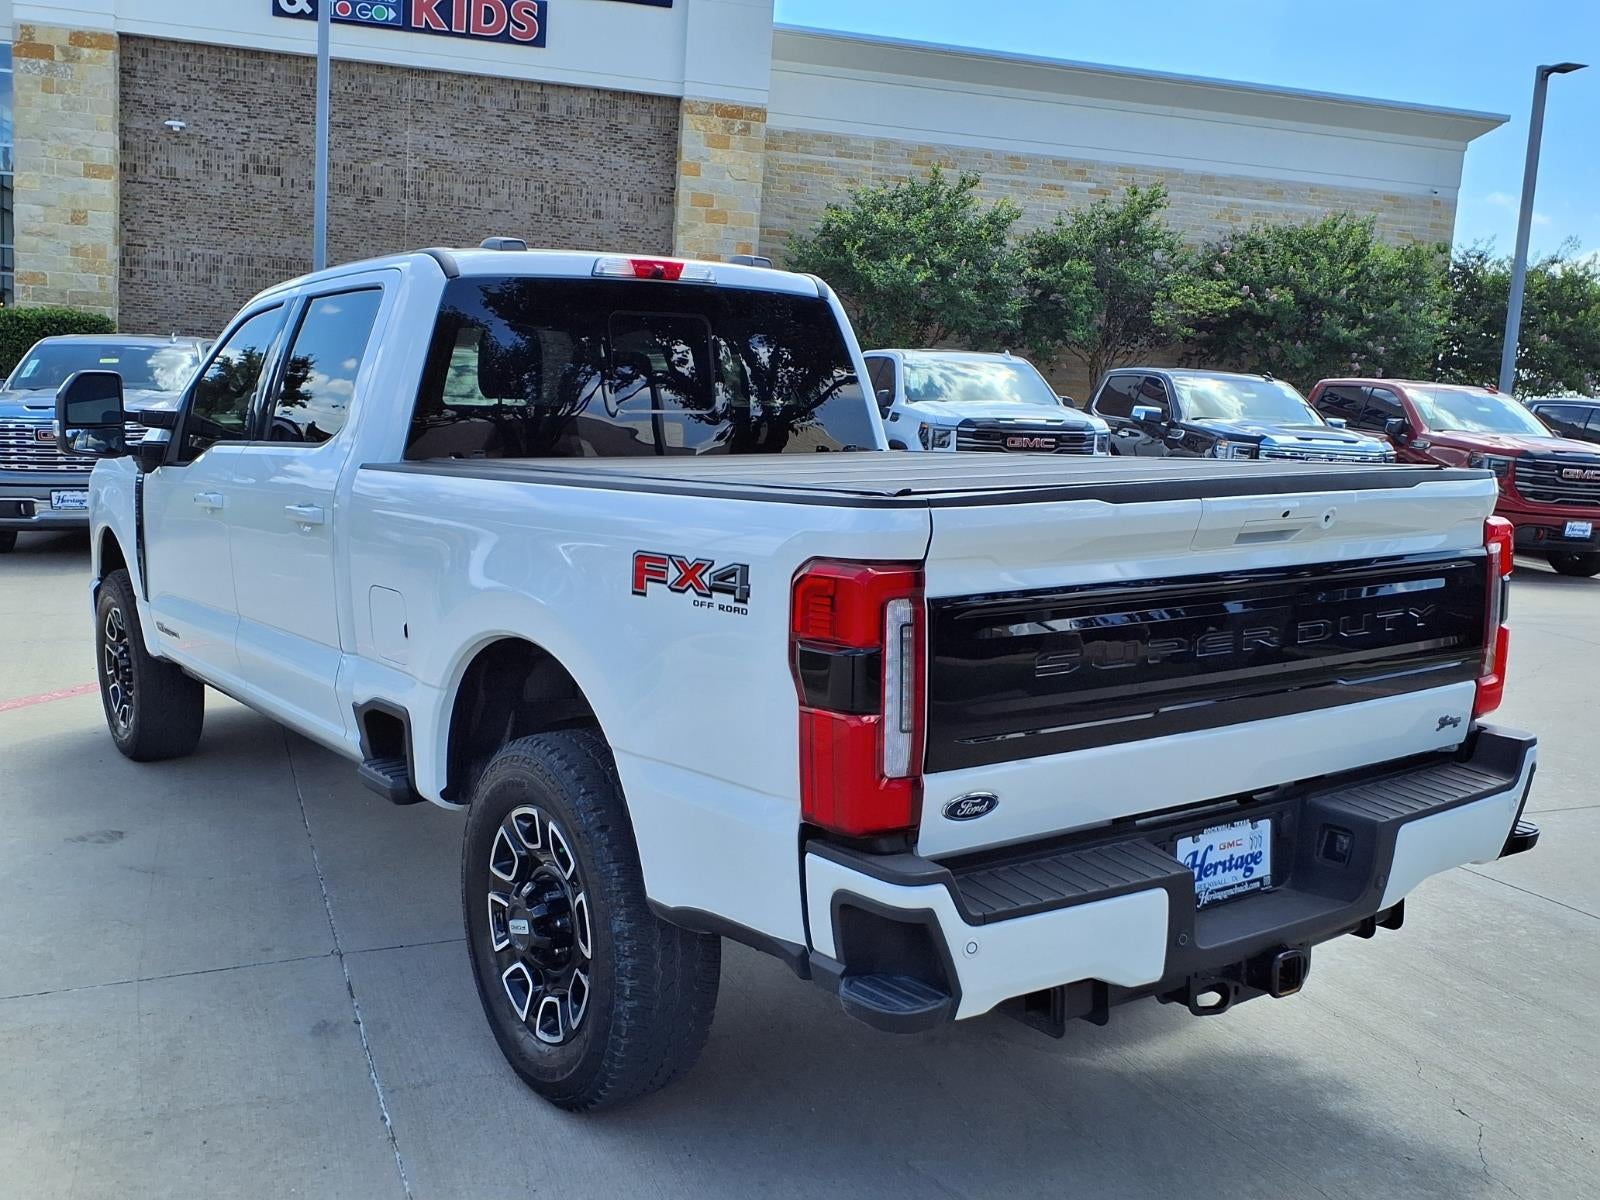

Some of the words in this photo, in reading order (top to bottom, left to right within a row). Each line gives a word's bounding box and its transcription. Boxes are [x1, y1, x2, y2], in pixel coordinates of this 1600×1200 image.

[356, 3, 388, 21] GO
[411, 0, 539, 42] KIDS
[1006, 437, 1056, 449] GMC
[632, 550, 750, 604] FX4
[692, 599, 715, 609] OFF
[718, 603, 748, 616] ROAD
[1034, 625, 1281, 677] SUPER
[1297, 604, 1438, 644] DUTY
[956, 798, 989, 816] Ford
[1218, 839, 1244, 851] GMC
[1184, 844, 1263, 882] Heritage
